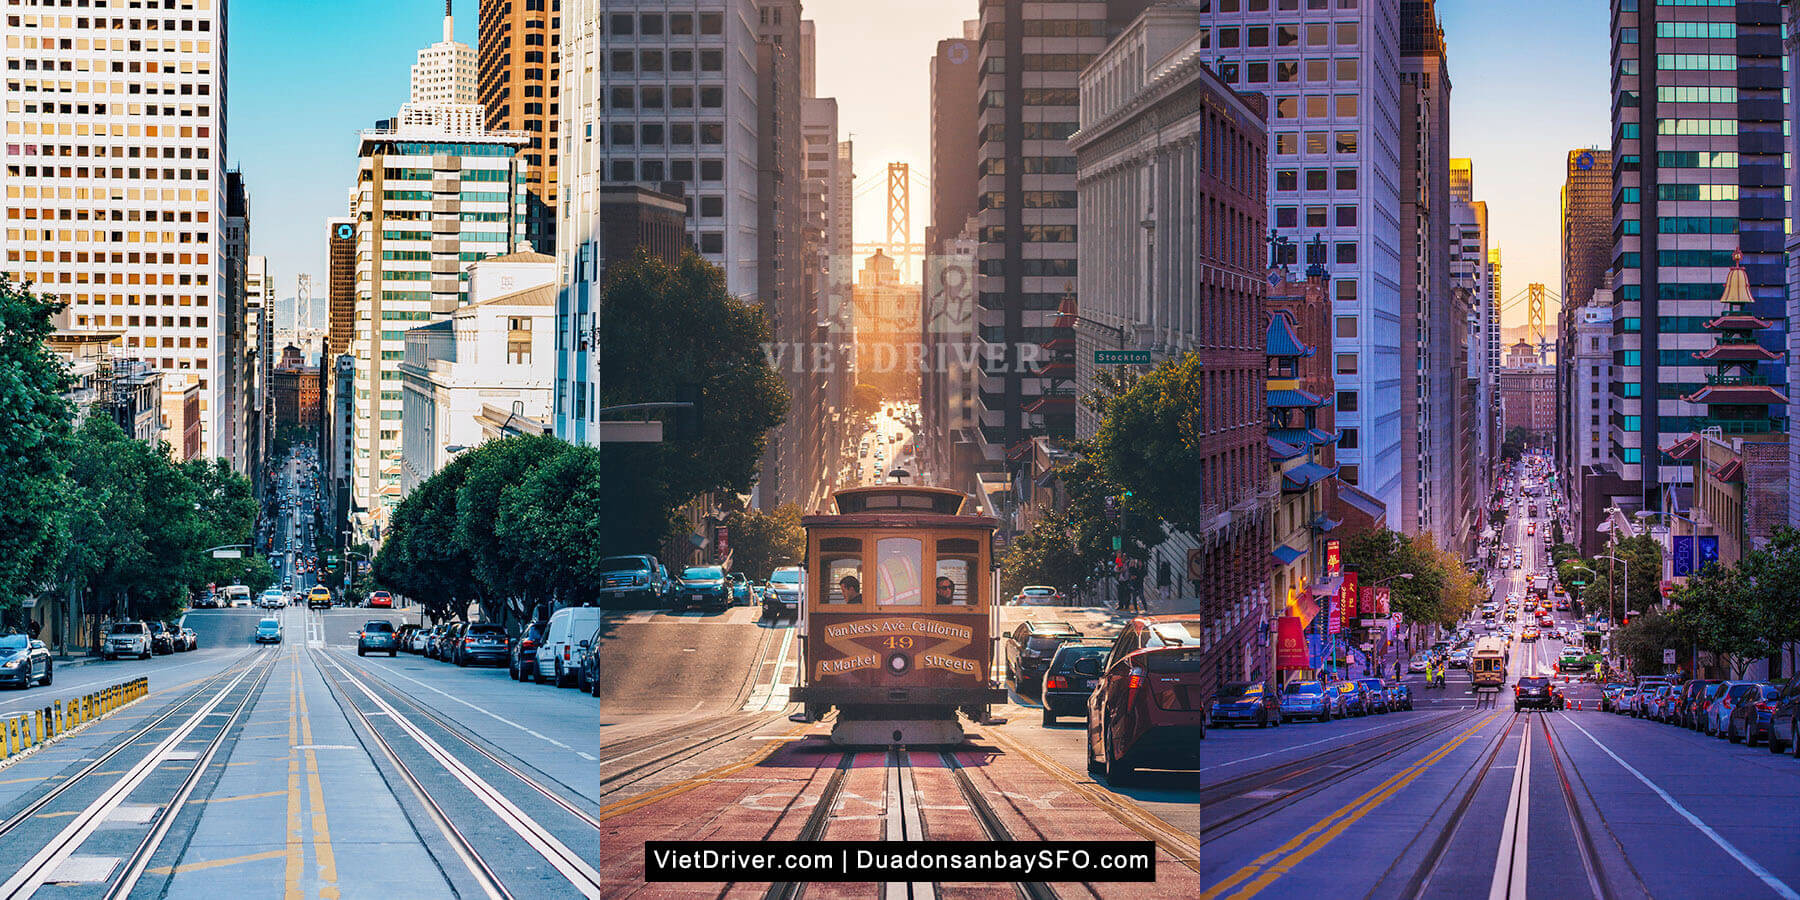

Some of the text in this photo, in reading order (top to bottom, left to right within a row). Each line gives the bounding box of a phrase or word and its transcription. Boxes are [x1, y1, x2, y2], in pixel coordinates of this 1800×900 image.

[1098, 353, 1148, 361] Stockton
[1679, 537, 1689, 576] OPERA
[828, 627, 848, 638] Van
[850, 623, 878, 635] Ness
[912, 621, 971, 639] California
[883, 636, 914, 649] 49
[822, 654, 876, 673] & Market
[925, 655, 975, 671] Streets
